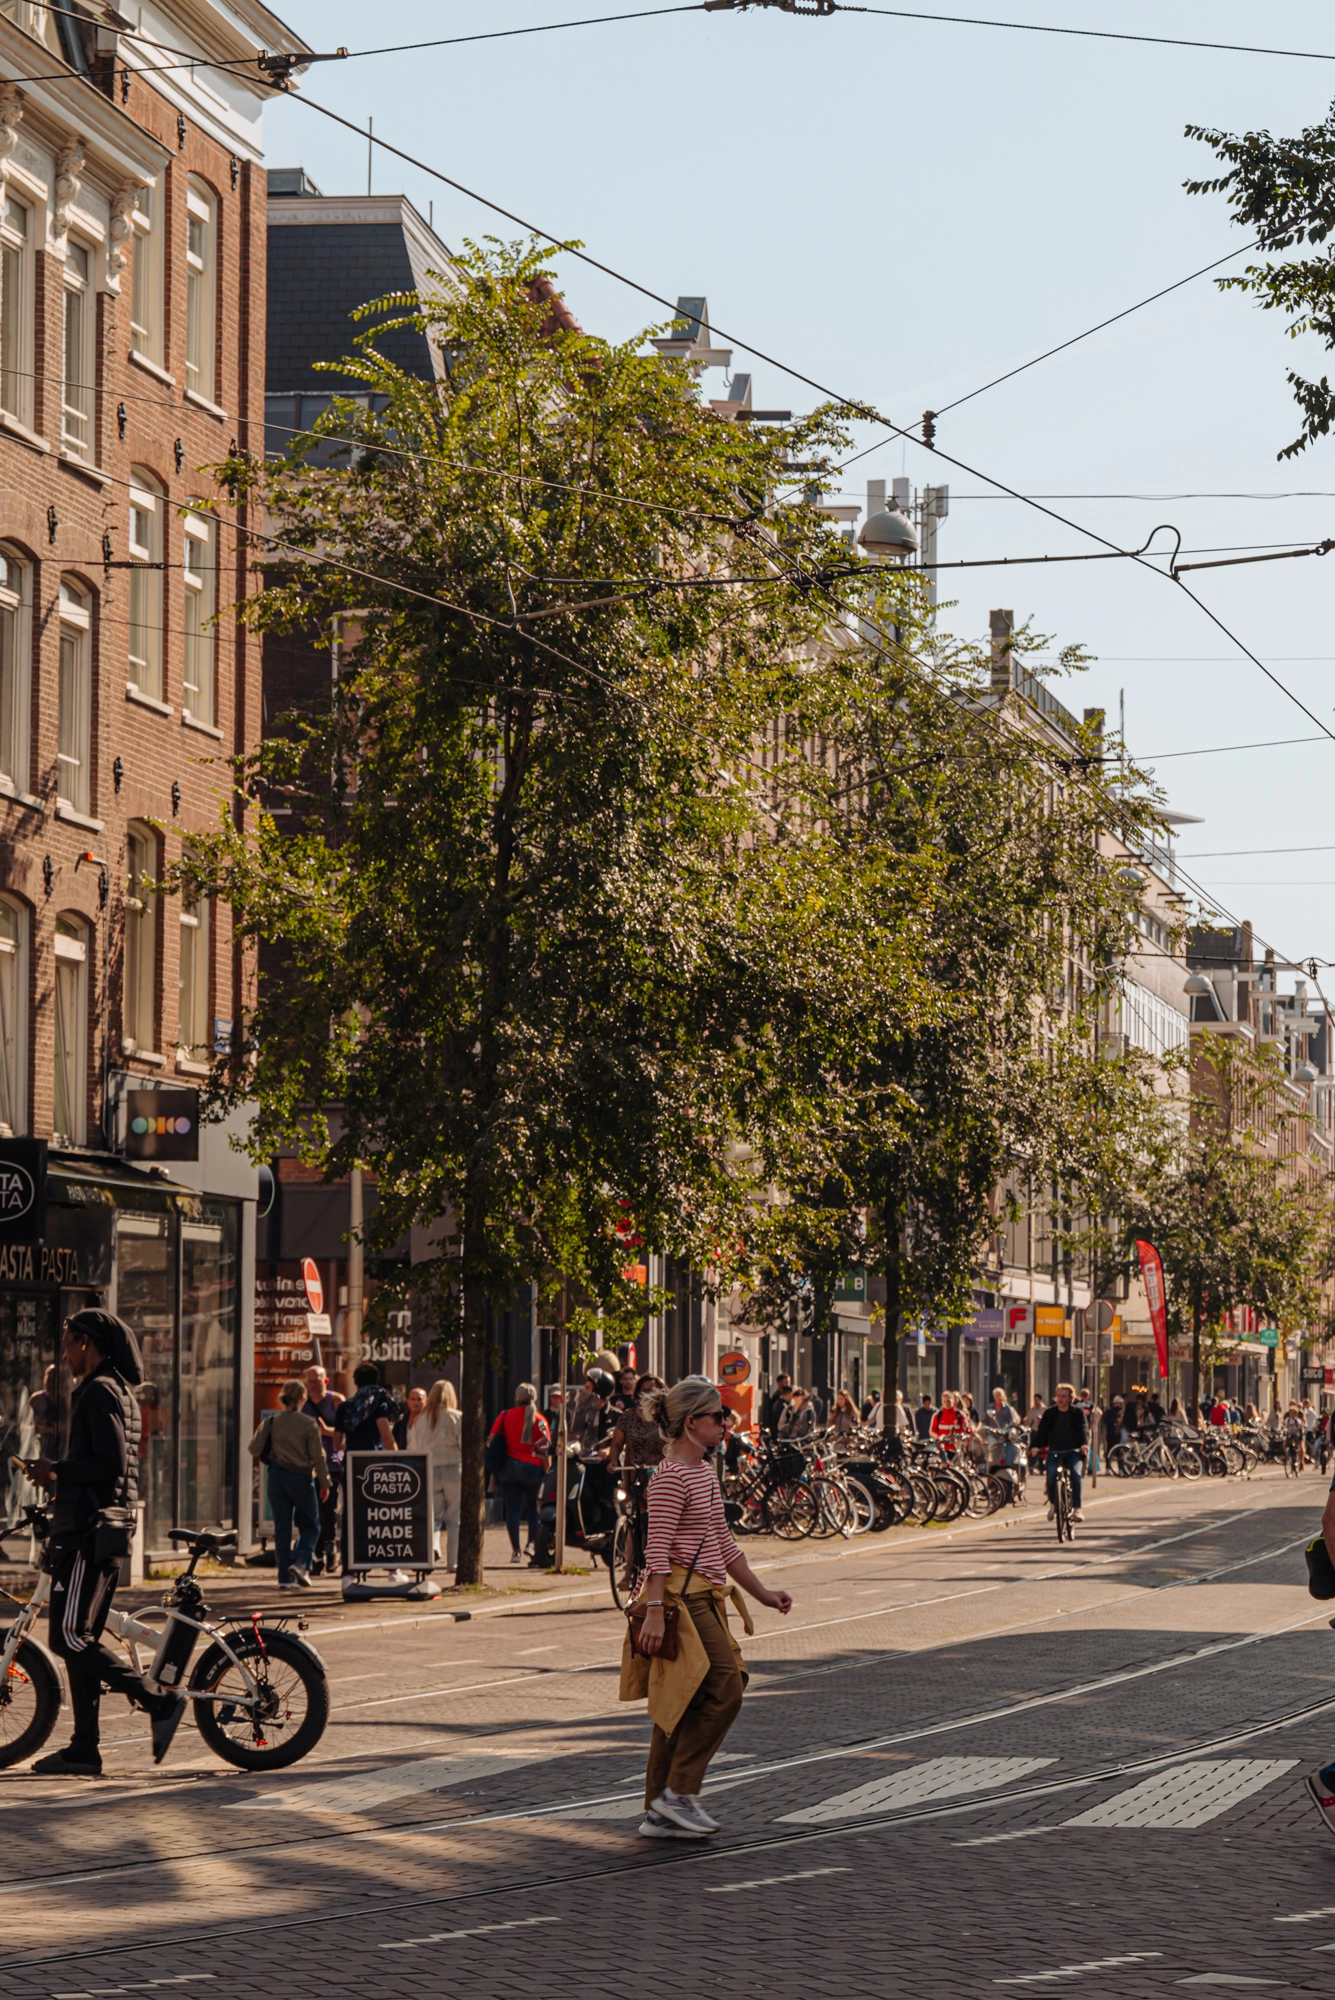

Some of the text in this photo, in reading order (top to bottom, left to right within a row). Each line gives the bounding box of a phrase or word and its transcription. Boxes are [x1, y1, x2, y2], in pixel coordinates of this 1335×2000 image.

[41, 1246, 79, 1283] PASTA
[1009, 1307, 1027, 1330] F
[1169, 1350, 1185, 1358] EMA
[373, 1471, 411, 1483] PASTA
[373, 1483, 412, 1494] PASTA
[367, 1507, 413, 1521] HOME
[367, 1526, 413, 1539] MADE
[368, 1544, 414, 1557] PASTA
